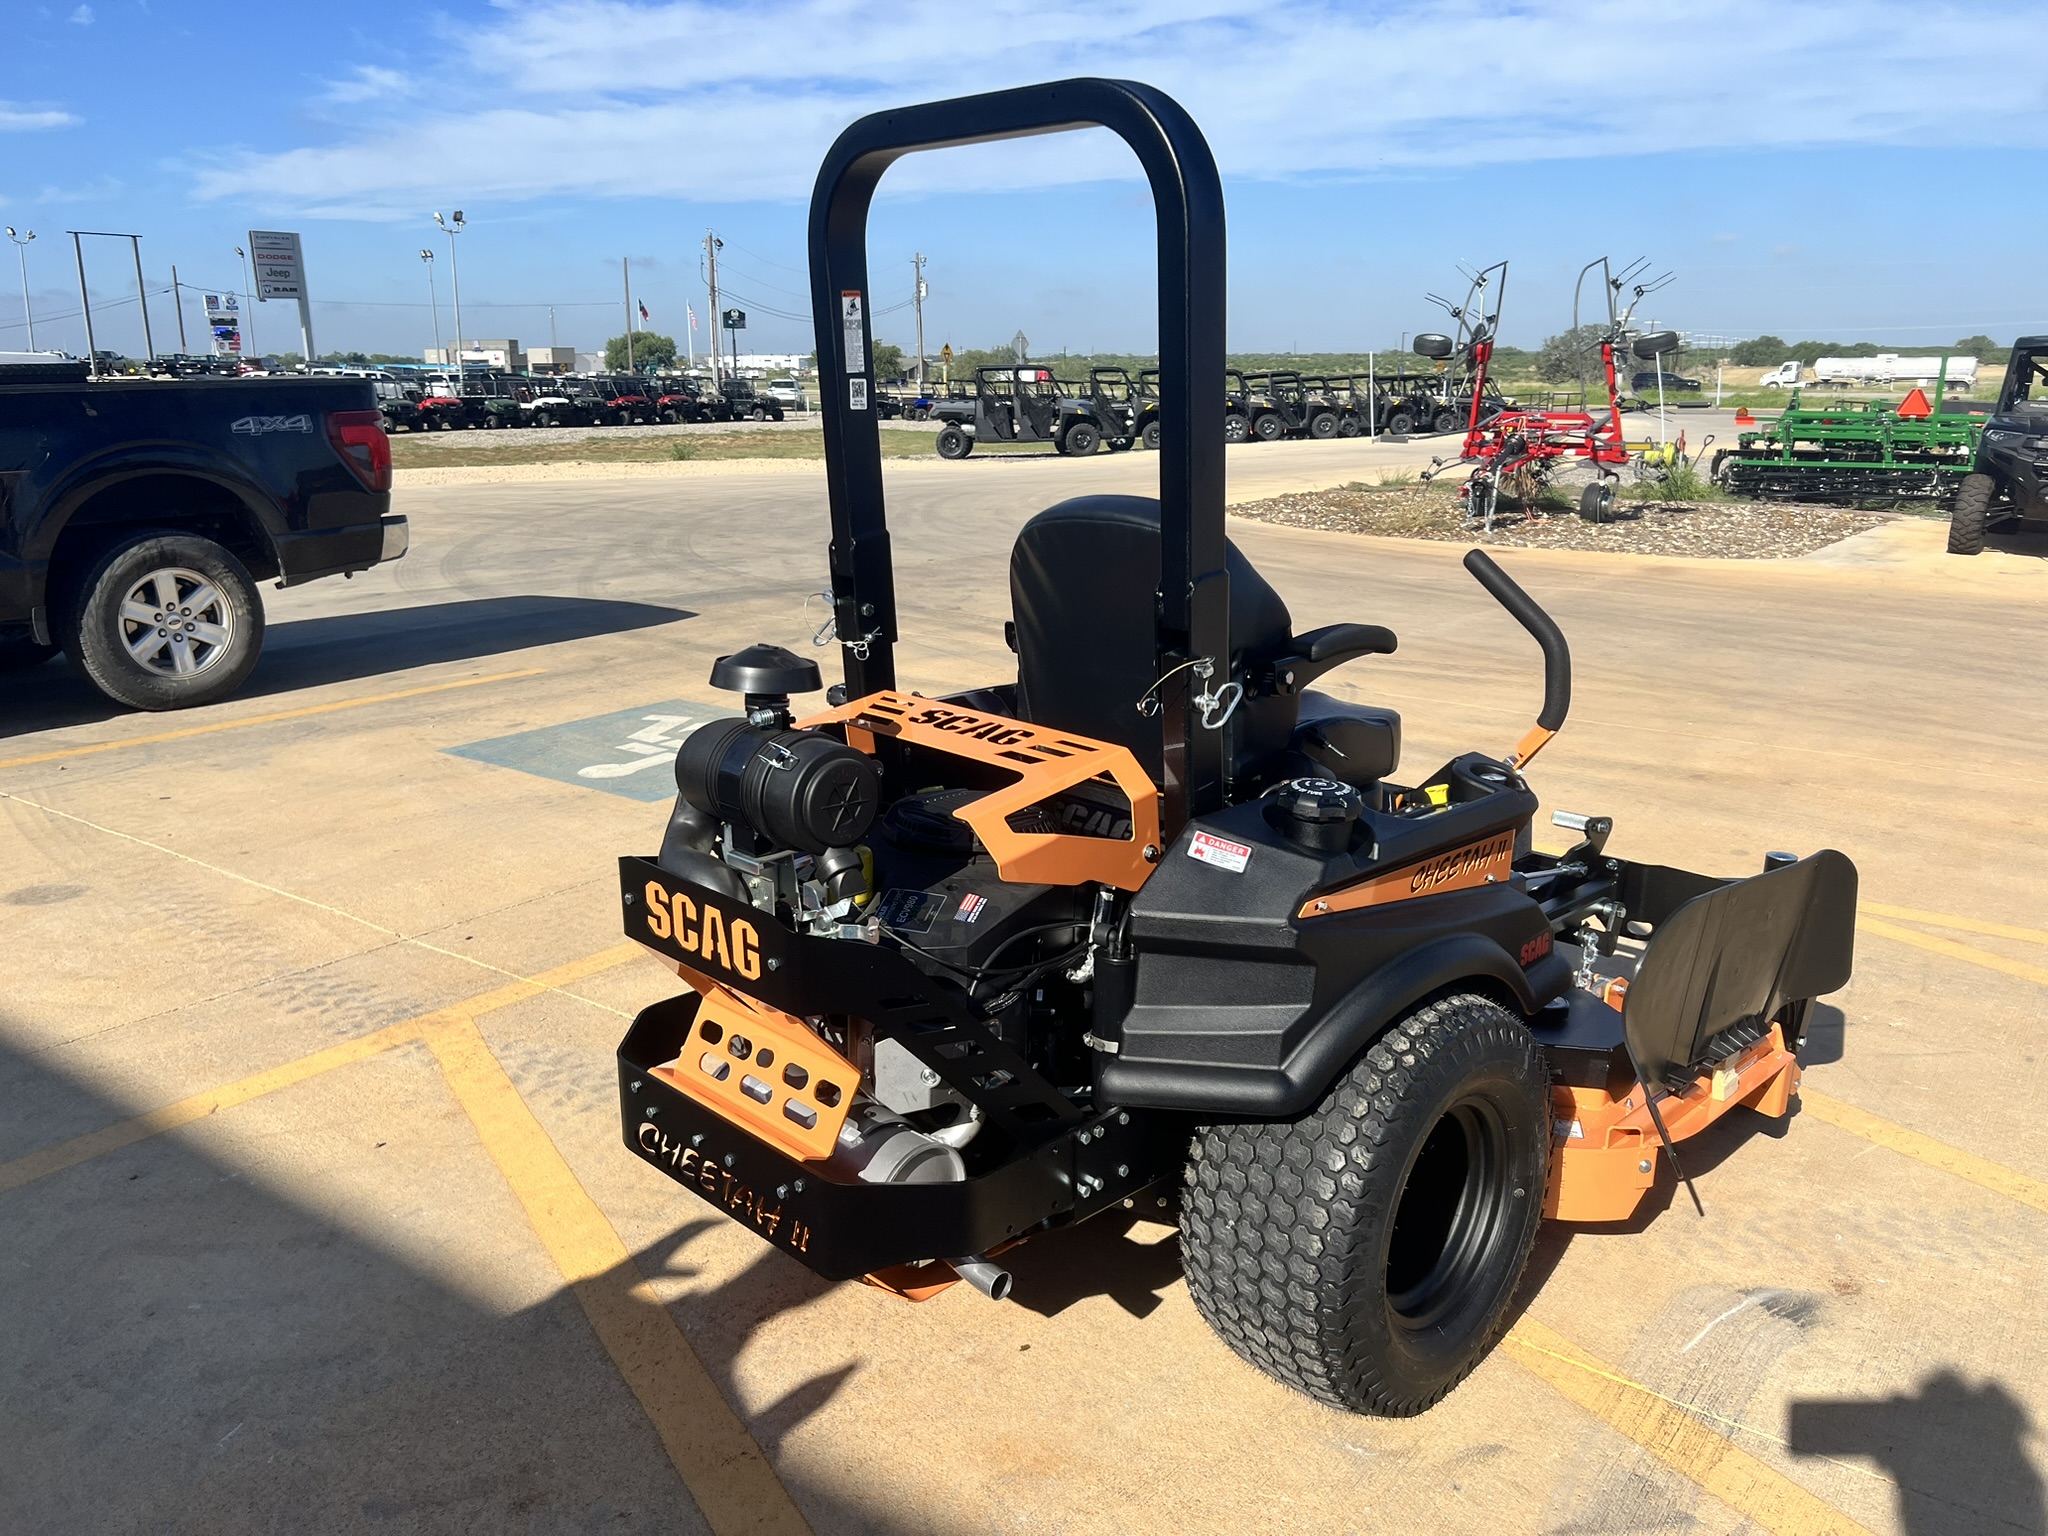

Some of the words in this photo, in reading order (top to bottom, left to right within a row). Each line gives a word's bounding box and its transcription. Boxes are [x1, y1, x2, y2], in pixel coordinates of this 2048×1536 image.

[266, 267, 291, 279] Jeep
[908, 709, 1035, 745] SCAG
[1208, 838, 1245, 855] DANGER
[1411, 841, 1495, 894] CHEETAH
[896, 895, 919, 923] ECV980
[645, 880, 761, 981] SCAG
[1520, 932, 1550, 967] SCAG
[636, 1122, 782, 1237] CHEETAH
[791, 1220, 811, 1253] II
